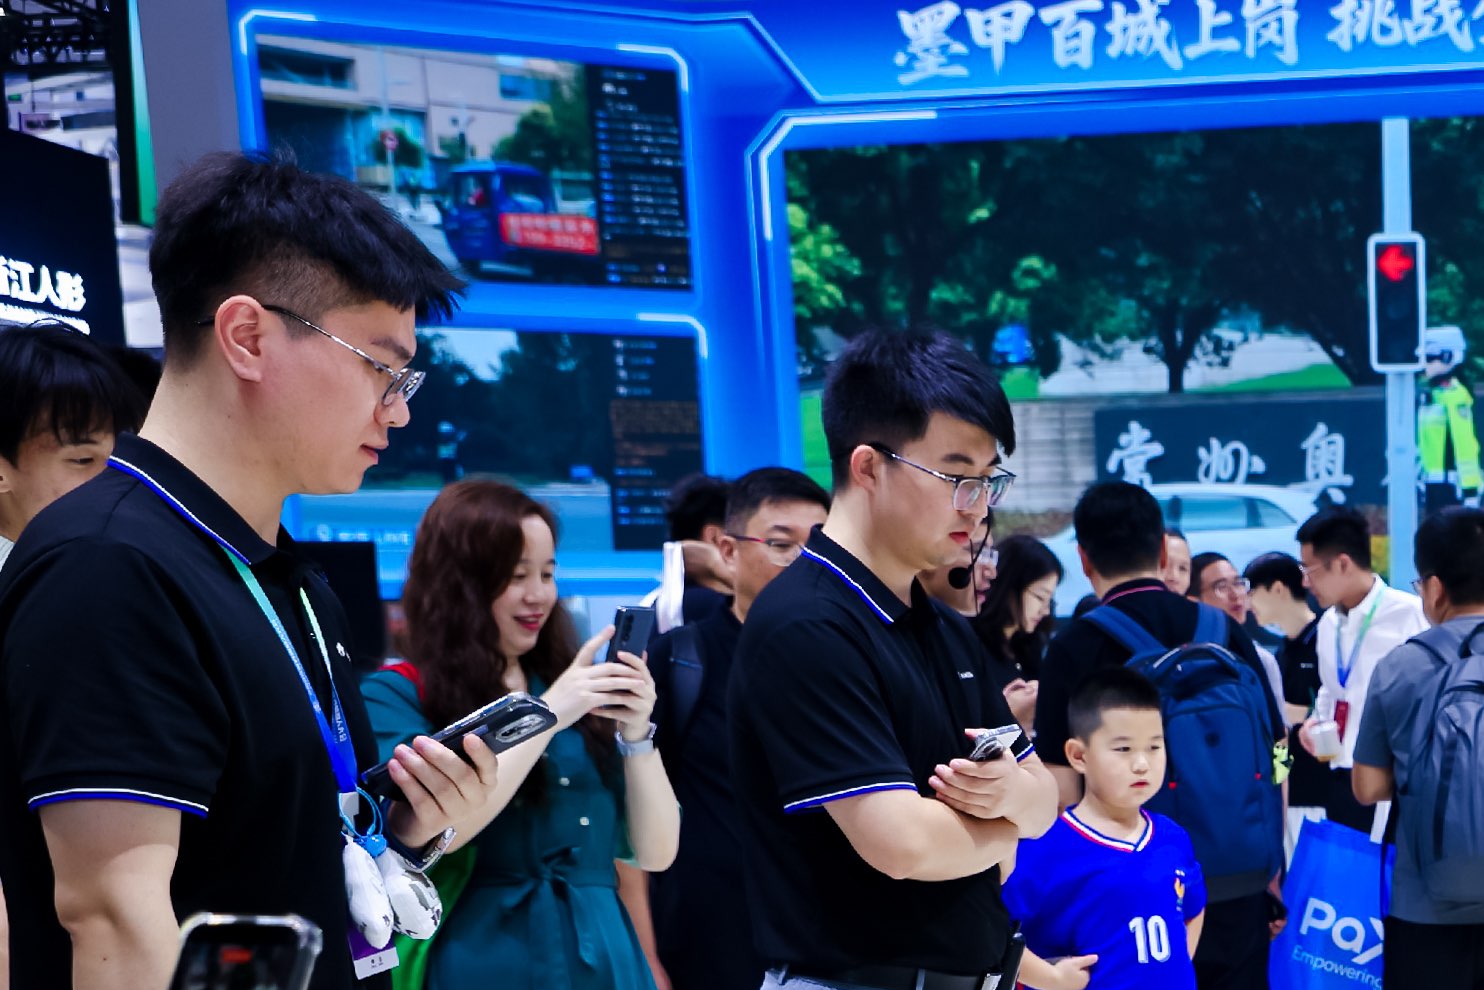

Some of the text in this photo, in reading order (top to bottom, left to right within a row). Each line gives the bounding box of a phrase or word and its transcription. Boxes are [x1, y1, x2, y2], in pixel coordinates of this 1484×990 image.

[893, 0, 1300, 85] 墨甲百城上岗
[1128, 914, 1171, 964] 10
